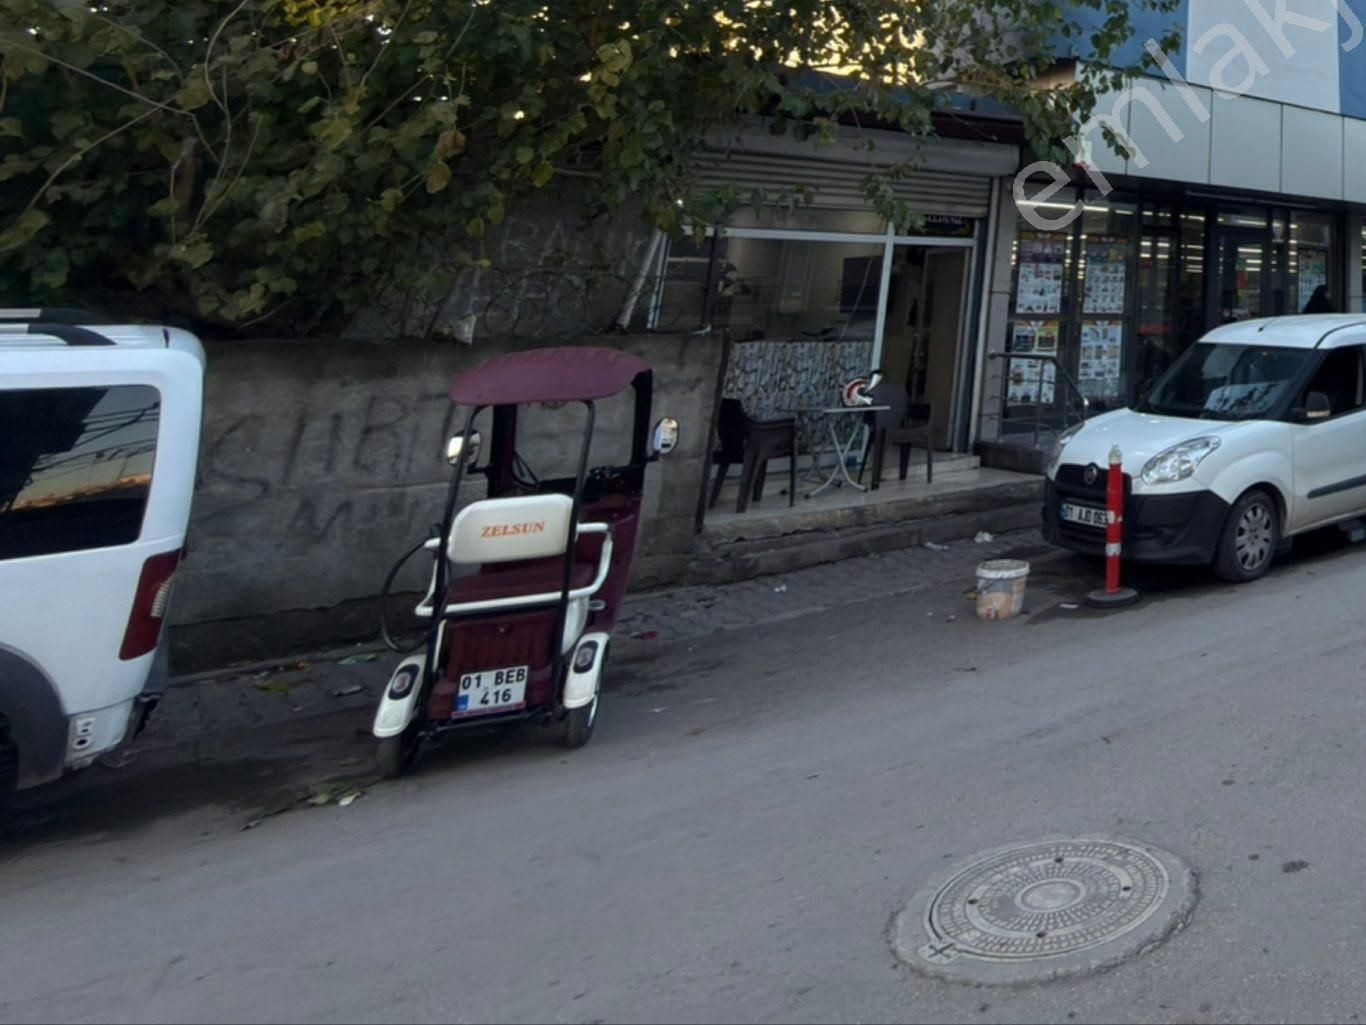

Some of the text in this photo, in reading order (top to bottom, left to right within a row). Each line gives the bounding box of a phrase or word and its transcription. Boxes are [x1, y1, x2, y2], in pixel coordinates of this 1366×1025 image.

[480, 520, 546, 538] ZELSUN
[462, 668, 526, 689] 01 BEB
[480, 688, 512, 705] 416
